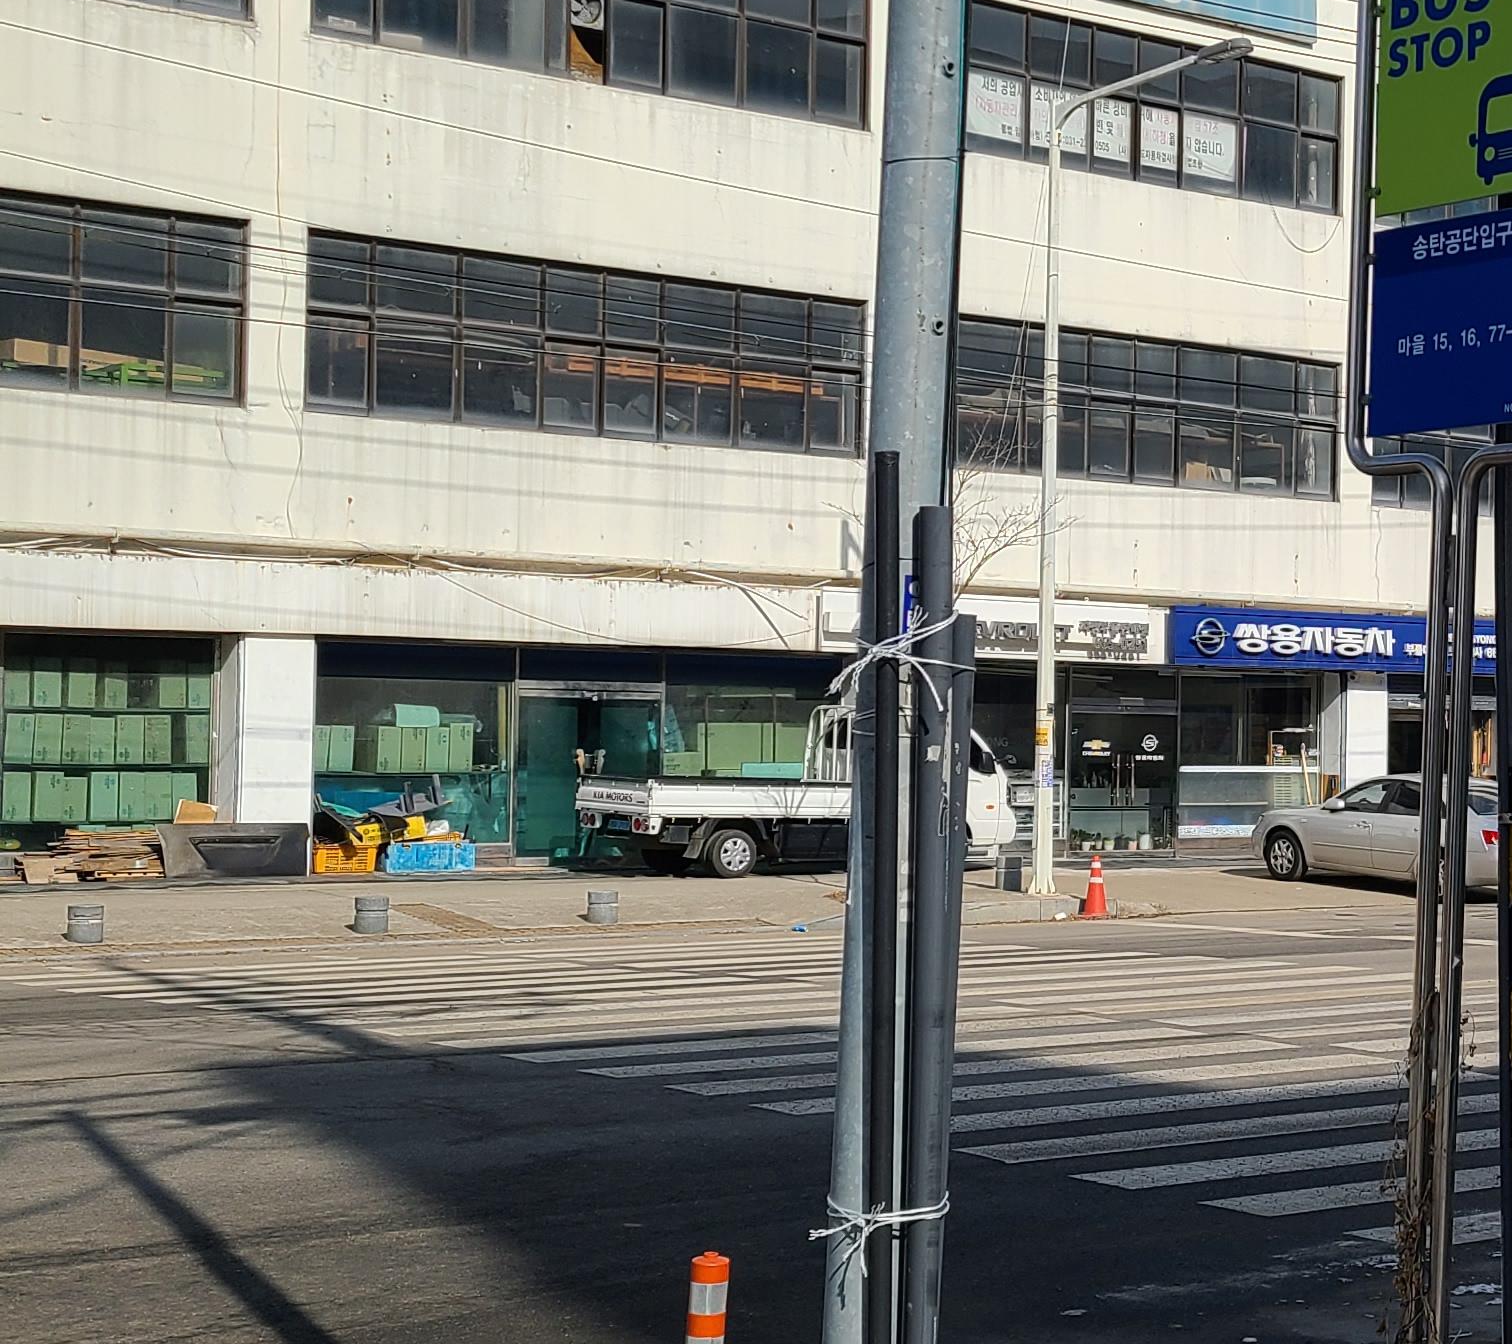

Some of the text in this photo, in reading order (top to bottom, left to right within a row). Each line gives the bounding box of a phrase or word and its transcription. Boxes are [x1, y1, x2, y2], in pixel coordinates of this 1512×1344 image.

[1387, 20, 1492, 78] STOP
[1397, 334, 1426, 357] 마을
[1432, 332, 1453, 352] 15,
[1460, 327, 1482, 349] 16,
[1233, 623, 1396, 657] 쌍용자동차
